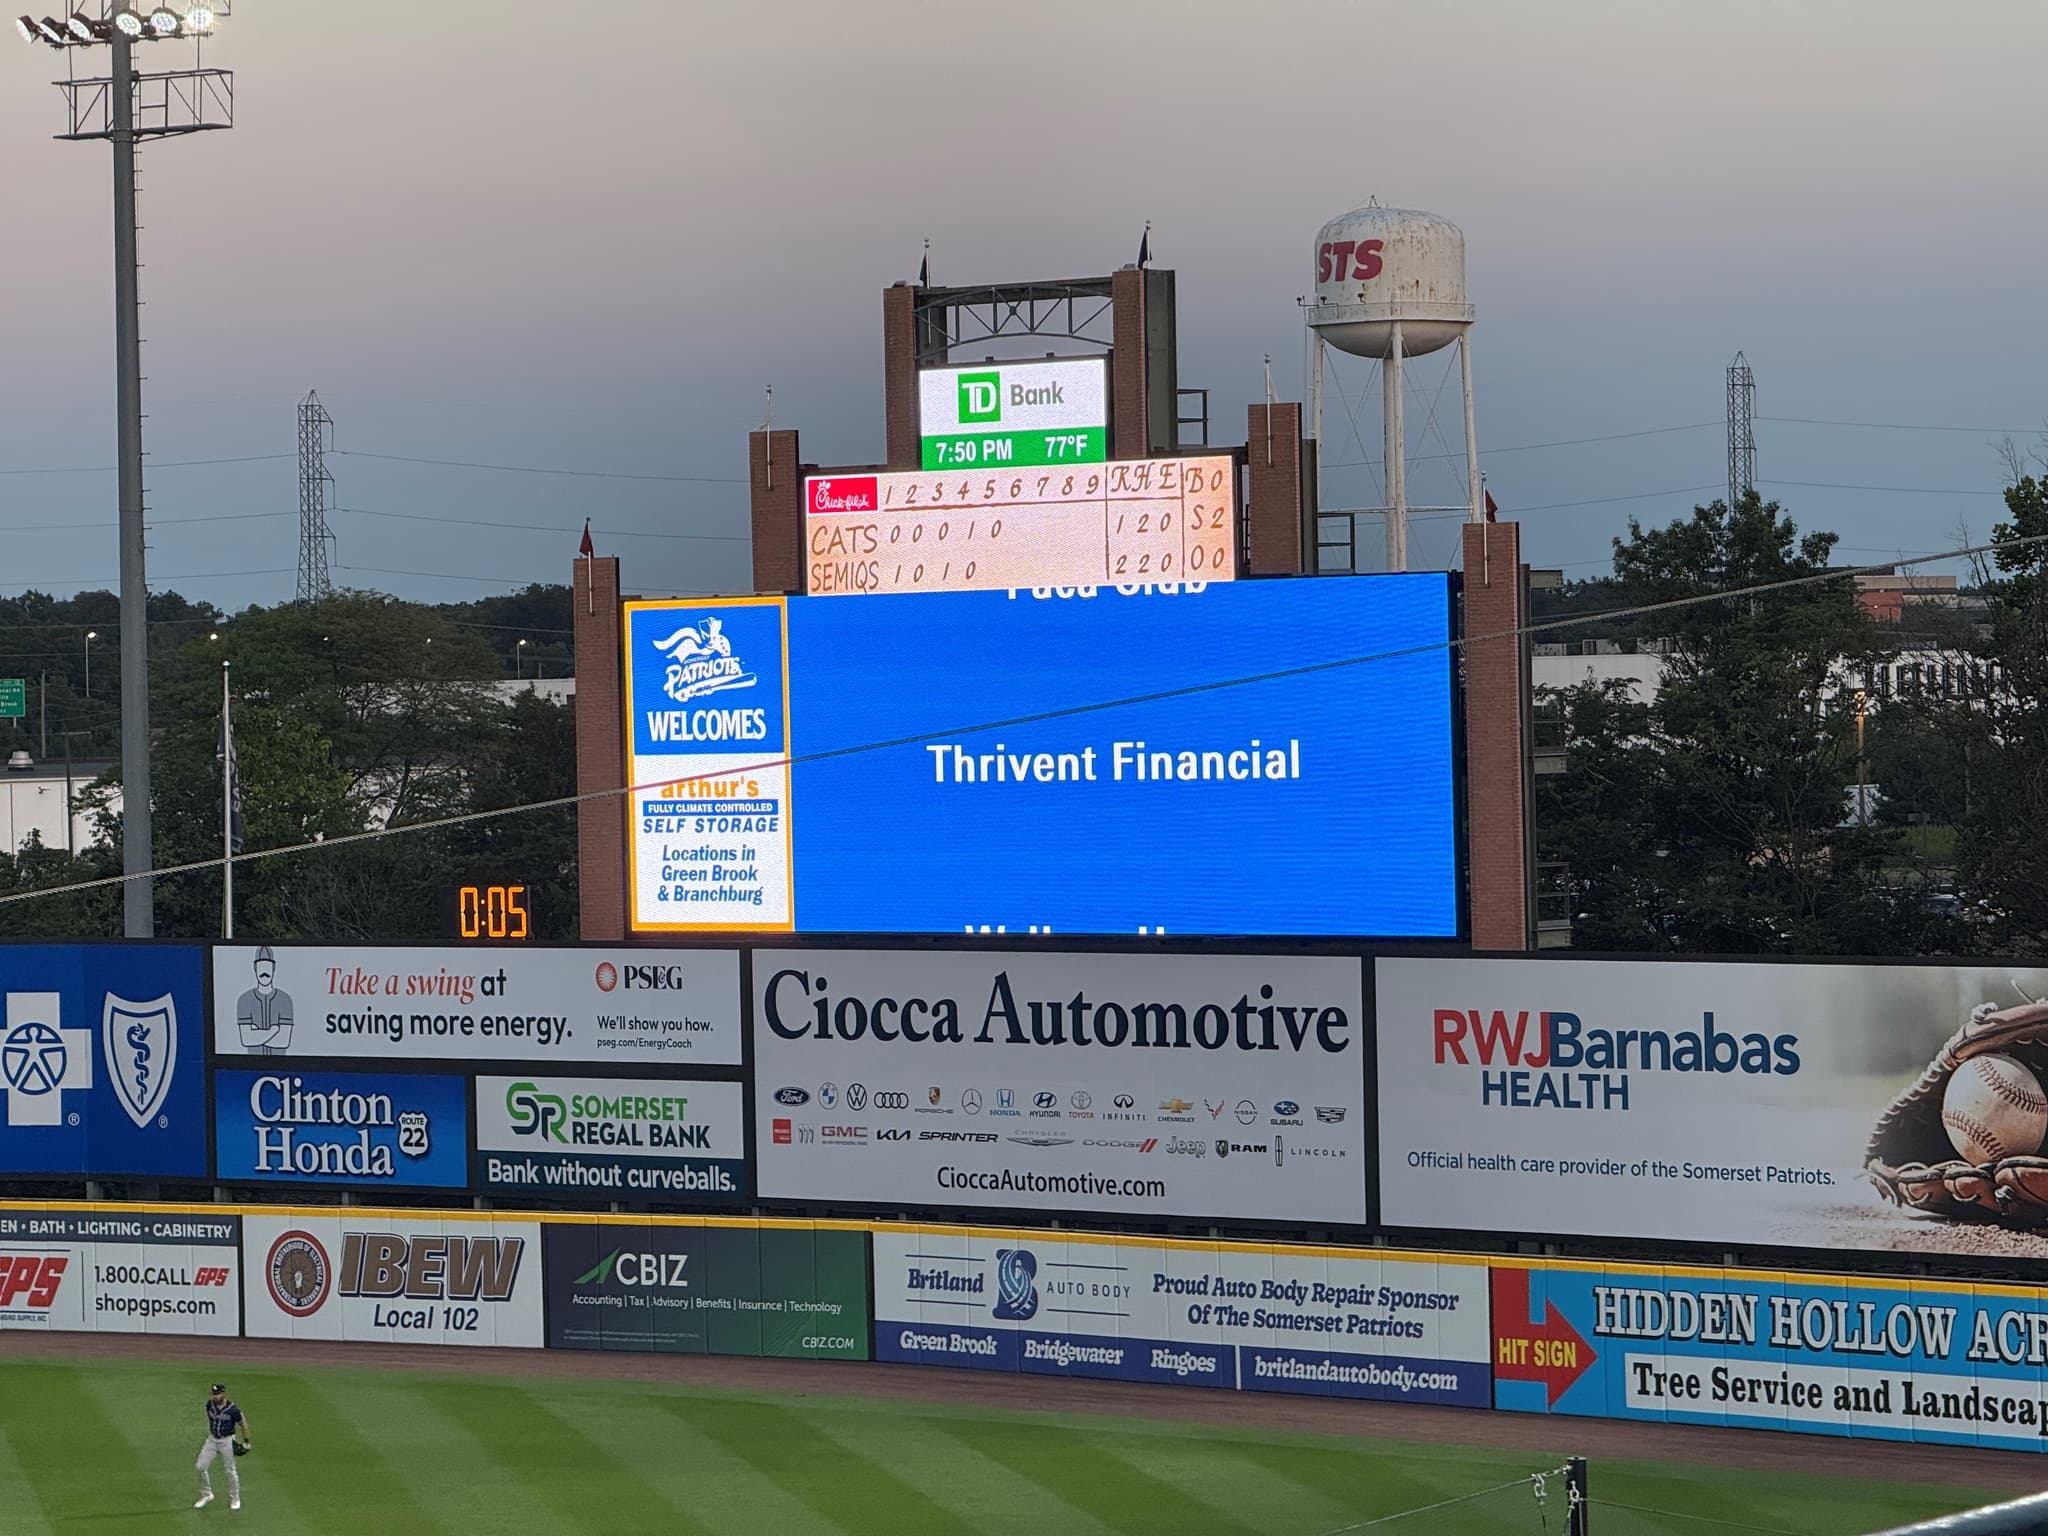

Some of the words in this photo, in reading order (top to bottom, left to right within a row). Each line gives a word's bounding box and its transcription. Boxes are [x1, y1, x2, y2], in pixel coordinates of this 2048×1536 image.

[1319, 239, 1384, 283] STS
[962, 382, 997, 413] TD
[1010, 382, 1064, 406] Bank
[936, 440, 976, 463] 7:50
[983, 438, 1013, 460] PM
[1045, 435, 1088, 458] 77°F
[906, 484, 918, 504] 2
[932, 482, 943, 501] 3
[957, 480, 969, 500] 4
[984, 480, 995, 499] 5
[1010, 478, 1022, 498] 6
[1037, 476, 1050, 497] 7
[1061, 475, 1074, 496] 8
[1086, 474, 1099, 495] 9
[1111, 465, 1131, 492] R
[1131, 462, 1155, 492] H
[1158, 463, 1177, 489] E
[1185, 467, 1204, 493] B
[812, 524, 878, 555] CATS
[891, 524, 900, 543] 0
[912, 524, 923, 543] 0
[939, 522, 949, 541] 0
[991, 519, 1002, 539] 0
[1137, 513, 1149, 533] 2
[1160, 512, 1171, 532] 0
[1191, 504, 1205, 530] S
[1210, 507, 1225, 529] 2
[914, 563, 924, 583] 0
[965, 561, 976, 580] 0
[1115, 554, 1128, 574] 2
[1138, 554, 1150, 574] 2
[1161, 553, 1172, 573] 0
[647, 708, 767, 742] WELCOMES
[926, 744, 1097, 782] Thrivent
[1113, 739, 1300, 781] Financial
[661, 776, 760, 798] arthur's
[648, 804, 674, 814] FULLY
[676, 803, 713, 813] CLIMATE
[714, 802, 773, 812] CONTROLLED
[643, 818, 686, 833] SELF
[695, 817, 779, 833] STORAGE
[663, 845, 737, 861] Locations
[741, 844, 756, 861] in
[662, 865, 707, 881] Green
[712, 864, 758, 881] Brook
[657, 885, 669, 901] &
[674, 885, 763, 906] Branchburg
[460, 887, 527, 937] 0:05
[326, 967, 379, 995] Take
[385, 975, 399, 995] a
[406, 968, 476, 1005] swing
[481, 968, 507, 996] at
[597, 1016, 626, 1030] We'll
[628, 1016, 658, 1031] show
[662, 1019, 683, 1034] you
[685, 1017, 714, 1032] how.
[763, 969, 964, 1044] Ciocca
[973, 971, 1350, 1054] Automotive
[326, 1006, 403, 1042] saving
[410, 1014, 475, 1035] more
[481, 1015, 573, 1045] energy.
[597, 1038, 692, 1050] pseg.com/EnergyCoach
[250, 1076, 394, 1125] Clinton
[1482, 1071, 1630, 1110] HEALTH
[401, 1116, 425, 1126] ROUTE
[571, 1094, 688, 1121] SOMERSET
[990, 1109, 1021, 1117] HONDA
[1029, 1110, 1061, 1118] HYUNDAI
[1069, 1112, 1094, 1120] TOYOTA
[1103, 1113, 1146, 1121] INFINITI
[403, 1128, 425, 1148] 22
[572, 1122, 644, 1146] REGAL
[649, 1124, 711, 1149] BANK
[821, 1126, 868, 1138] GMC
[918, 1131, 998, 1143] SPRINTER
[253, 1126, 394, 1175] Honda
[1166, 1136, 1206, 1158] Jeep
[1231, 1144, 1267, 1153] RAM
[1291, 1149, 1346, 1158] LINCOLN
[488, 1158, 540, 1184] Bank
[544, 1159, 622, 1188] without
[627, 1163, 737, 1192] curveballs.
[937, 1166, 1166, 1198] CioccaAutomotive.com
[1408, 1151, 1463, 1169] Official
[1467, 1153, 1516, 1172] health
[1520, 1159, 1555, 1174] care
[1559, 1158, 1627, 1177] provider
[1630, 1160, 1649, 1177] of
[1651, 1161, 1679, 1178] the
[1682, 1162, 1762, 1183] Somerset
[1766, 1165, 1836, 1186] Patriots.
[30, 1221, 66, 1234] BATH
[78, 1221, 141, 1235] LIGHTING
[153, 1223, 232, 1239] CABINETRY
[94, 1265, 191, 1286] 1.800.CALL
[193, 1267, 230, 1287] GPS
[339, 1232, 525, 1301] IBEW
[615, 1253, 688, 1287] CBIZ
[907, 1269, 984, 1293] Britland
[1047, 1282, 1085, 1296] AUTO
[1092, 1284, 1131, 1298] BODY
[1152, 1273, 1209, 1296] Proud
[1212, 1277, 1257, 1299] Auto
[1260, 1279, 1307, 1307] Body
[1312, 1282, 1375, 1307] Repair
[1378, 1286, 1459, 1312] Sponsor
[95, 1293, 216, 1317] shopgps.com
[374, 1304, 434, 1329] Local
[443, 1307, 479, 1331] 102
[572, 1294, 622, 1308] Accounting
[630, 1296, 644, 1306] Tax
[696, 1298, 731, 1309] Benefits
[738, 1300, 782, 1311] Insurance
[790, 1301, 842, 1315] Technology
[1188, 1304, 1209, 1325] Of
[1214, 1306, 1249, 1327] The
[1253, 1308, 1342, 1333] Somerset
[1346, 1314, 1424, 1338] Patriots
[1594, 1286, 1758, 1345] HIDDEN
[1767, 1294, 1957, 1359] HOLLOW
[801, 1337, 855, 1349] CBIZ.COM
[900, 1331, 947, 1352] Green
[950, 1334, 998, 1355] Brook
[1024, 1339, 1124, 1367] Bridgewater
[1499, 1337, 1528, 1365] HIT
[1534, 1339, 1576, 1369] SIGN
[1151, 1350, 1216, 1376] Ringoes
[1255, 1356, 1458, 1392] britlandautobody.com
[1633, 1362, 1701, 1399] Tree
[1712, 1366, 1823, 1409] Service
[1833, 1379, 1890, 1414] and
